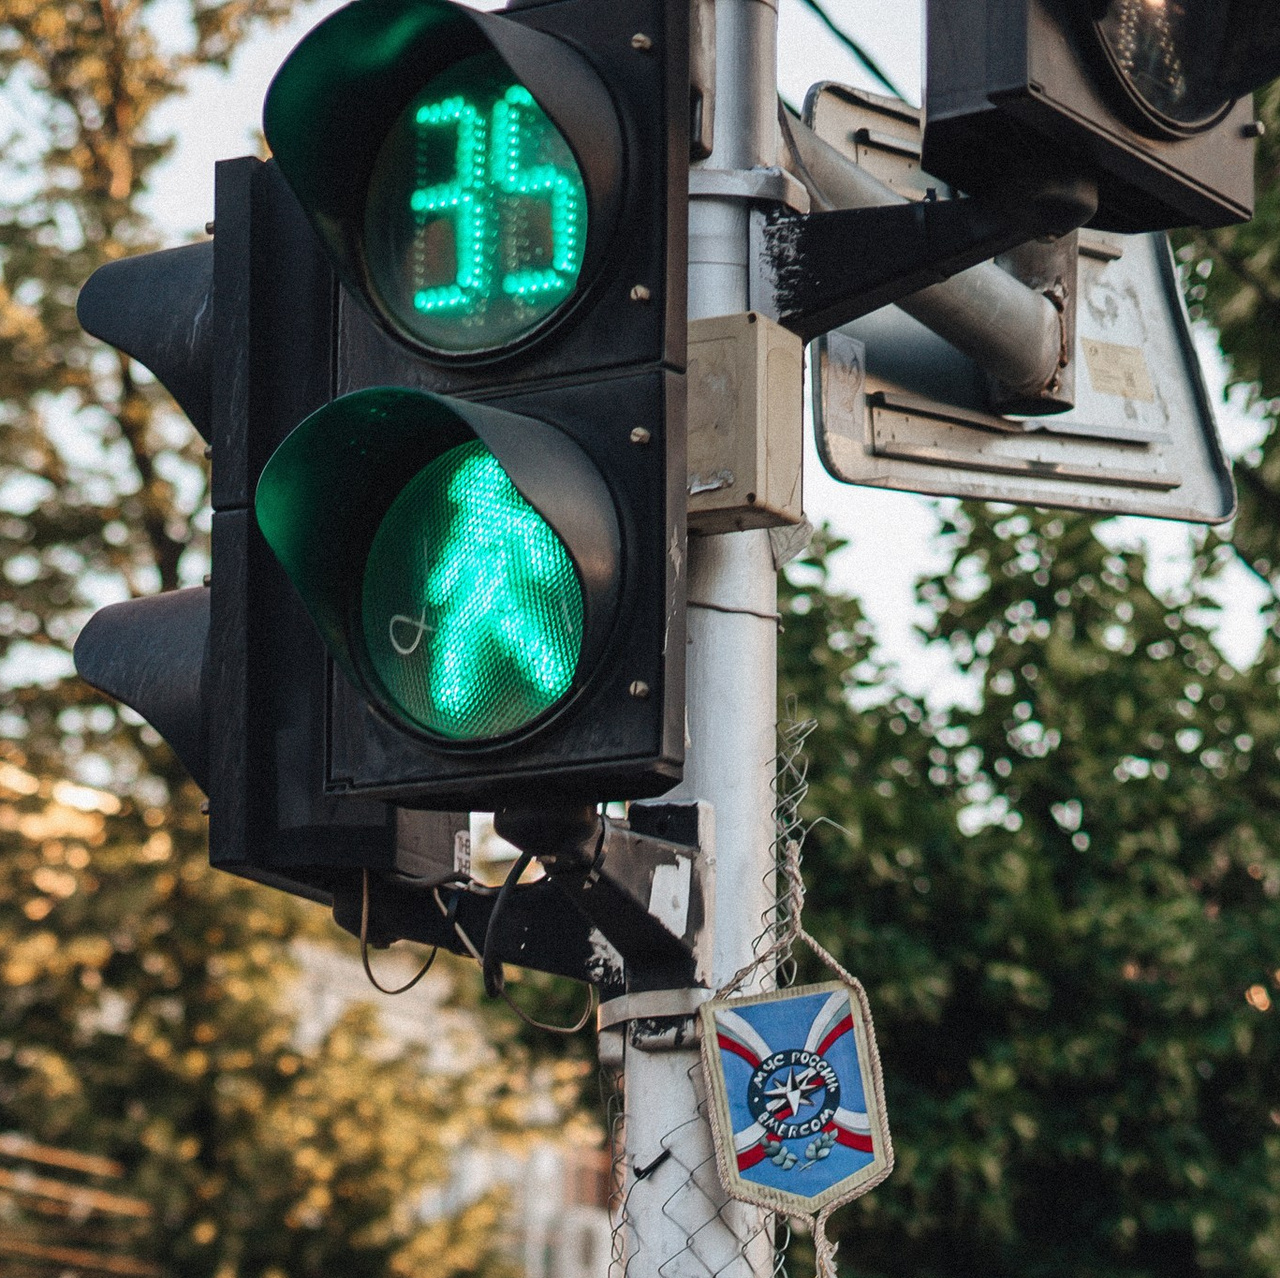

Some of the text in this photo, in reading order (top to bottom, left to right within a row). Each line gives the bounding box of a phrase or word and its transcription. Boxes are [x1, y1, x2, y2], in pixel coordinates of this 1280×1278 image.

[411, 85, 577, 309] 35
[753, 1052, 839, 1091] МЧС РОССИИ
[757, 1108, 835, 1139] EMERCOM
